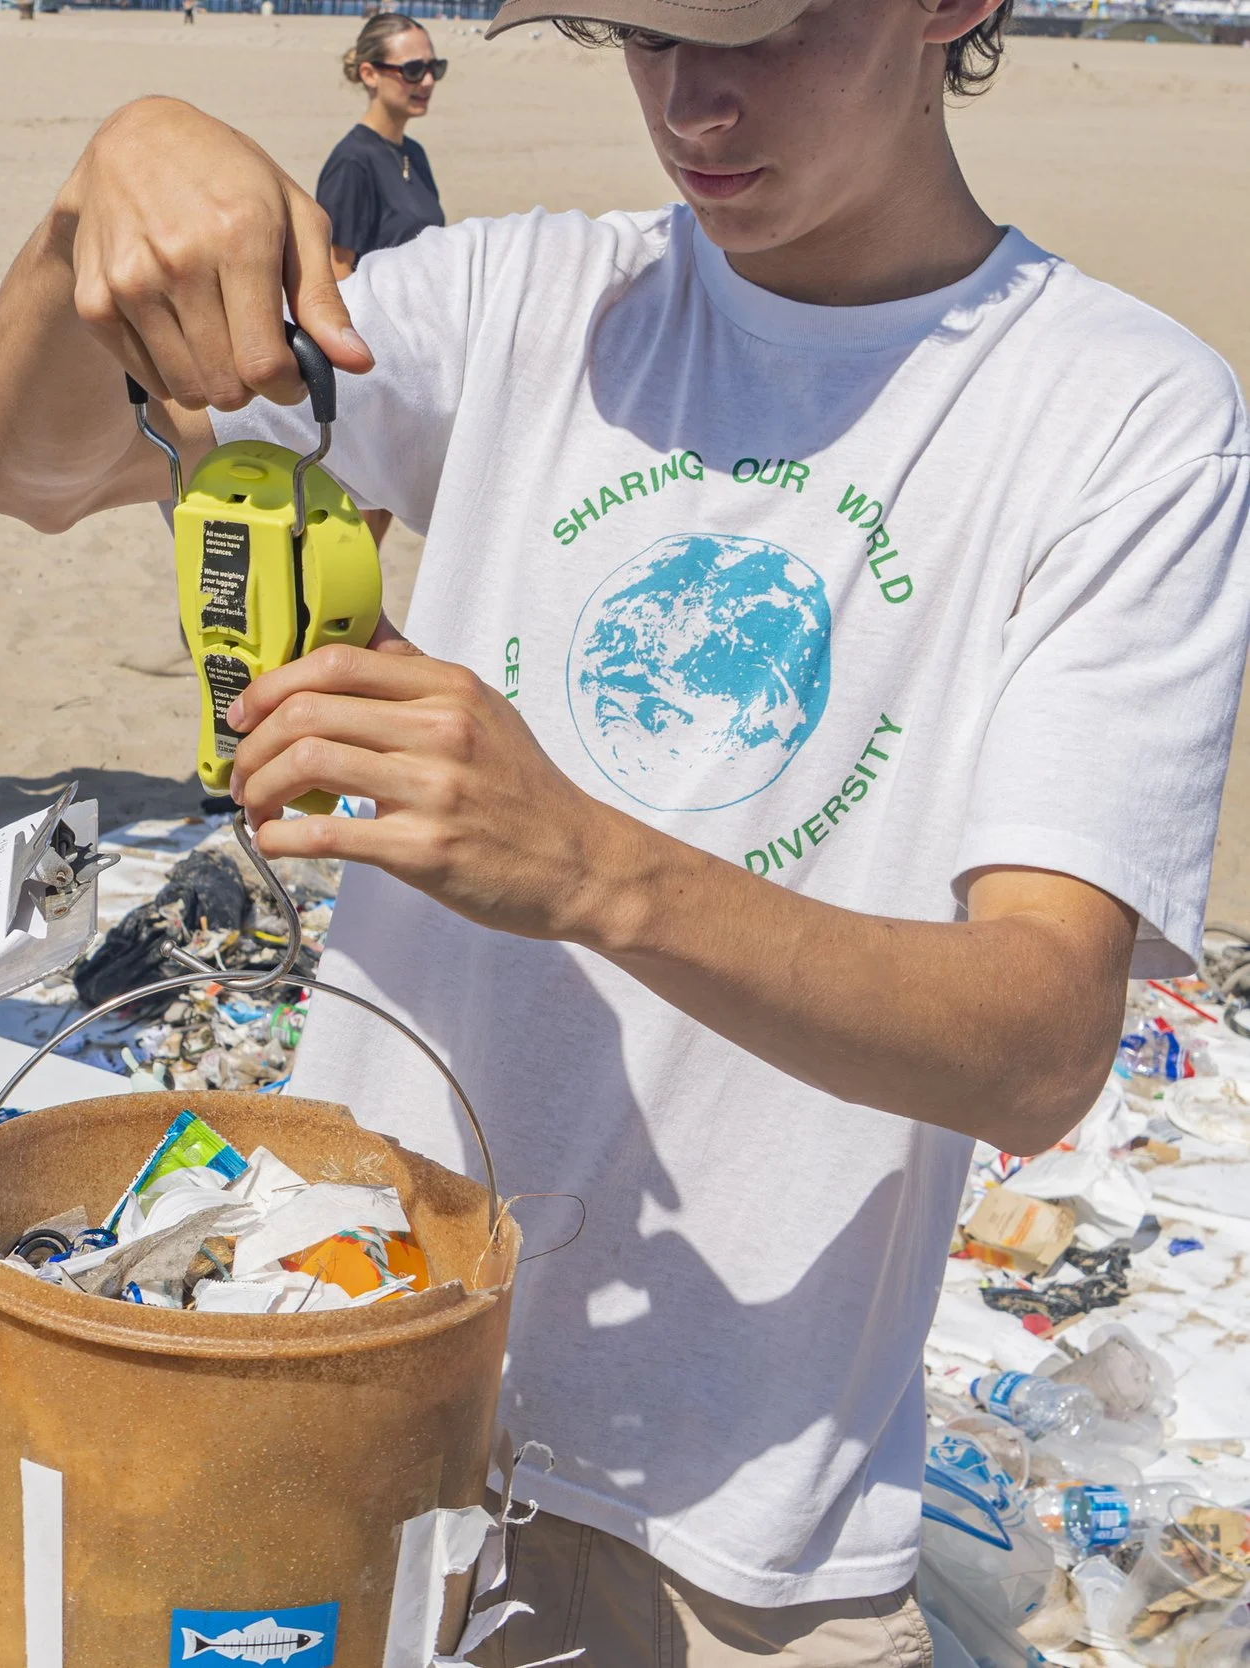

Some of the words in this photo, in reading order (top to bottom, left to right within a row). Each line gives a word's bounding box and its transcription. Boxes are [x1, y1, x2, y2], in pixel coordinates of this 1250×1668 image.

[553, 450, 704, 546] SHARING
[732, 457, 811, 493] OUR
[836, 484, 914, 604] WORLD
[214, 532, 244, 541] mechanical
[206, 539, 226, 547] devices
[226, 541, 240, 550] have
[206, 548, 233, 556] variances.
[204, 568, 220, 576] When
[220, 572, 244, 582] weighing
[216, 578, 239, 588] luggage,
[214, 690, 230, 699] Check
[744, 712, 903, 877] DIVERSITY
